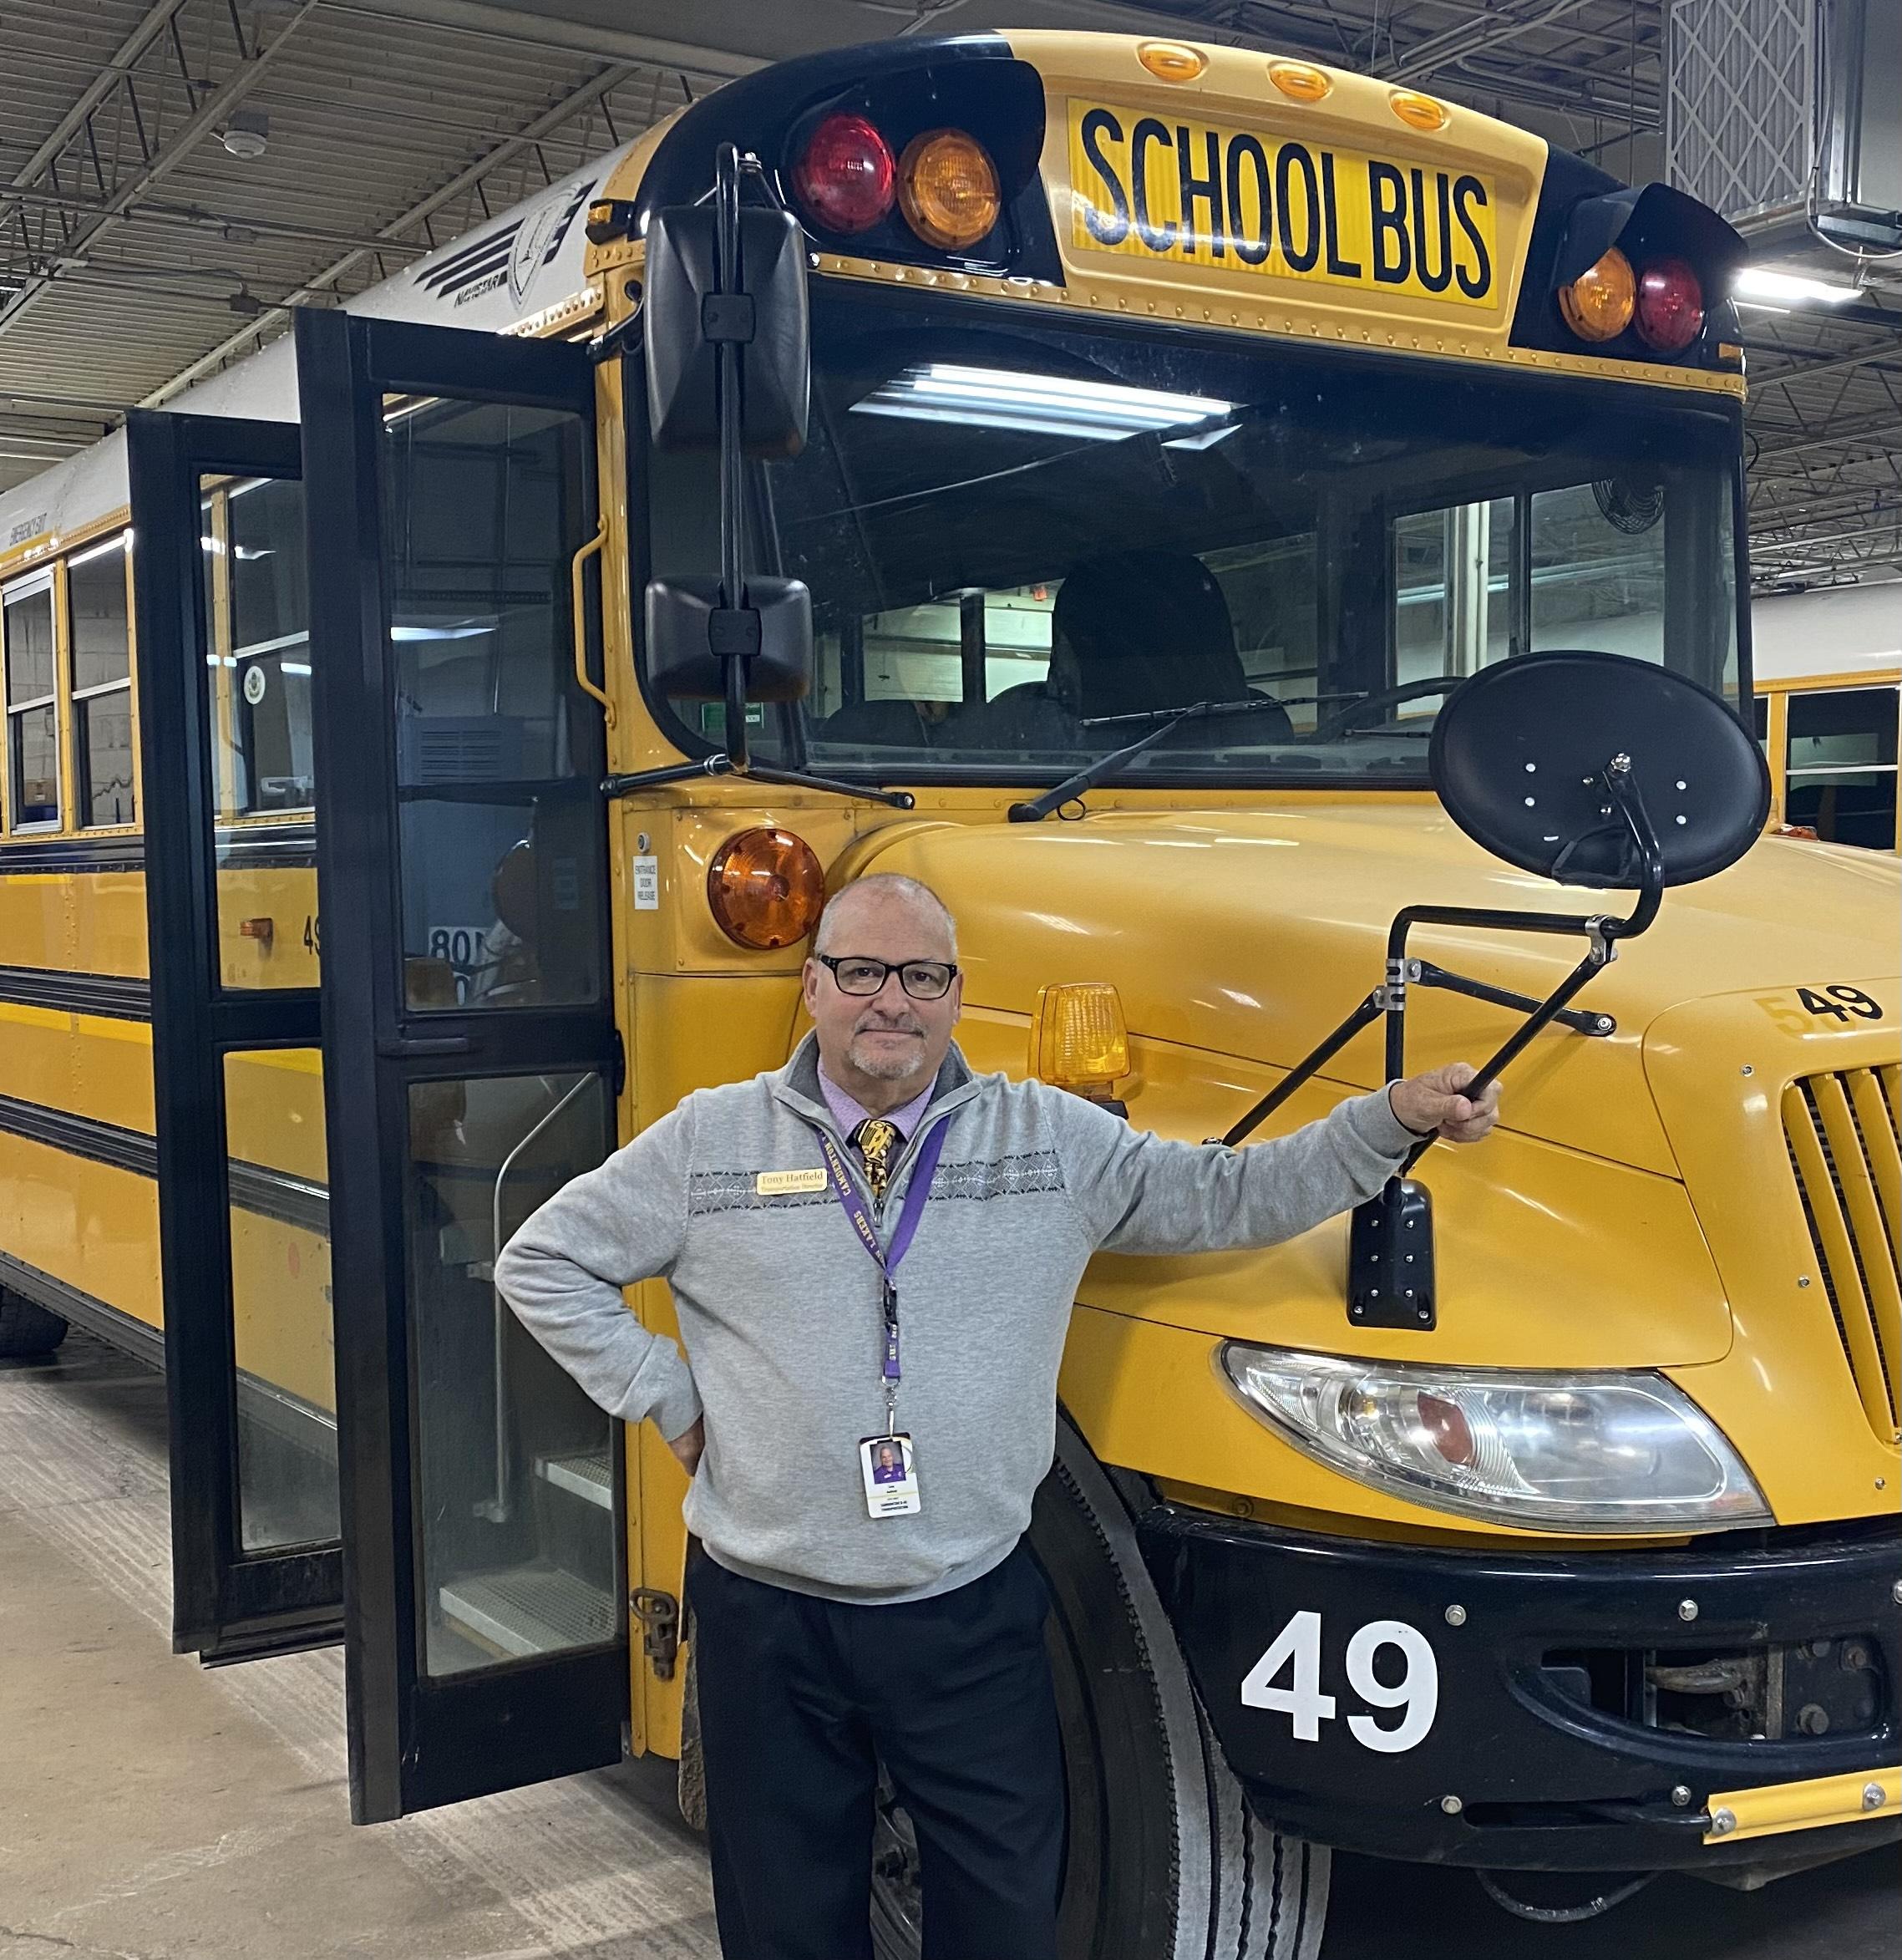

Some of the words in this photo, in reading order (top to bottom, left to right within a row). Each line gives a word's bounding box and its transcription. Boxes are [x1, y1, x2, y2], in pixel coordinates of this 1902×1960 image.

[1081, 108, 1362, 278] SCHOOL
[1367, 160, 1491, 299] BUS
[1796, 985, 1884, 1020] 49
[761, 1175, 783, 1185] Tony
[786, 1171, 823, 1182] Hatfield
[824, 1140, 852, 1196] CAMDENTON
[853, 1210, 876, 1249] LAKERS
[1241, 1610, 1438, 1753] 49
